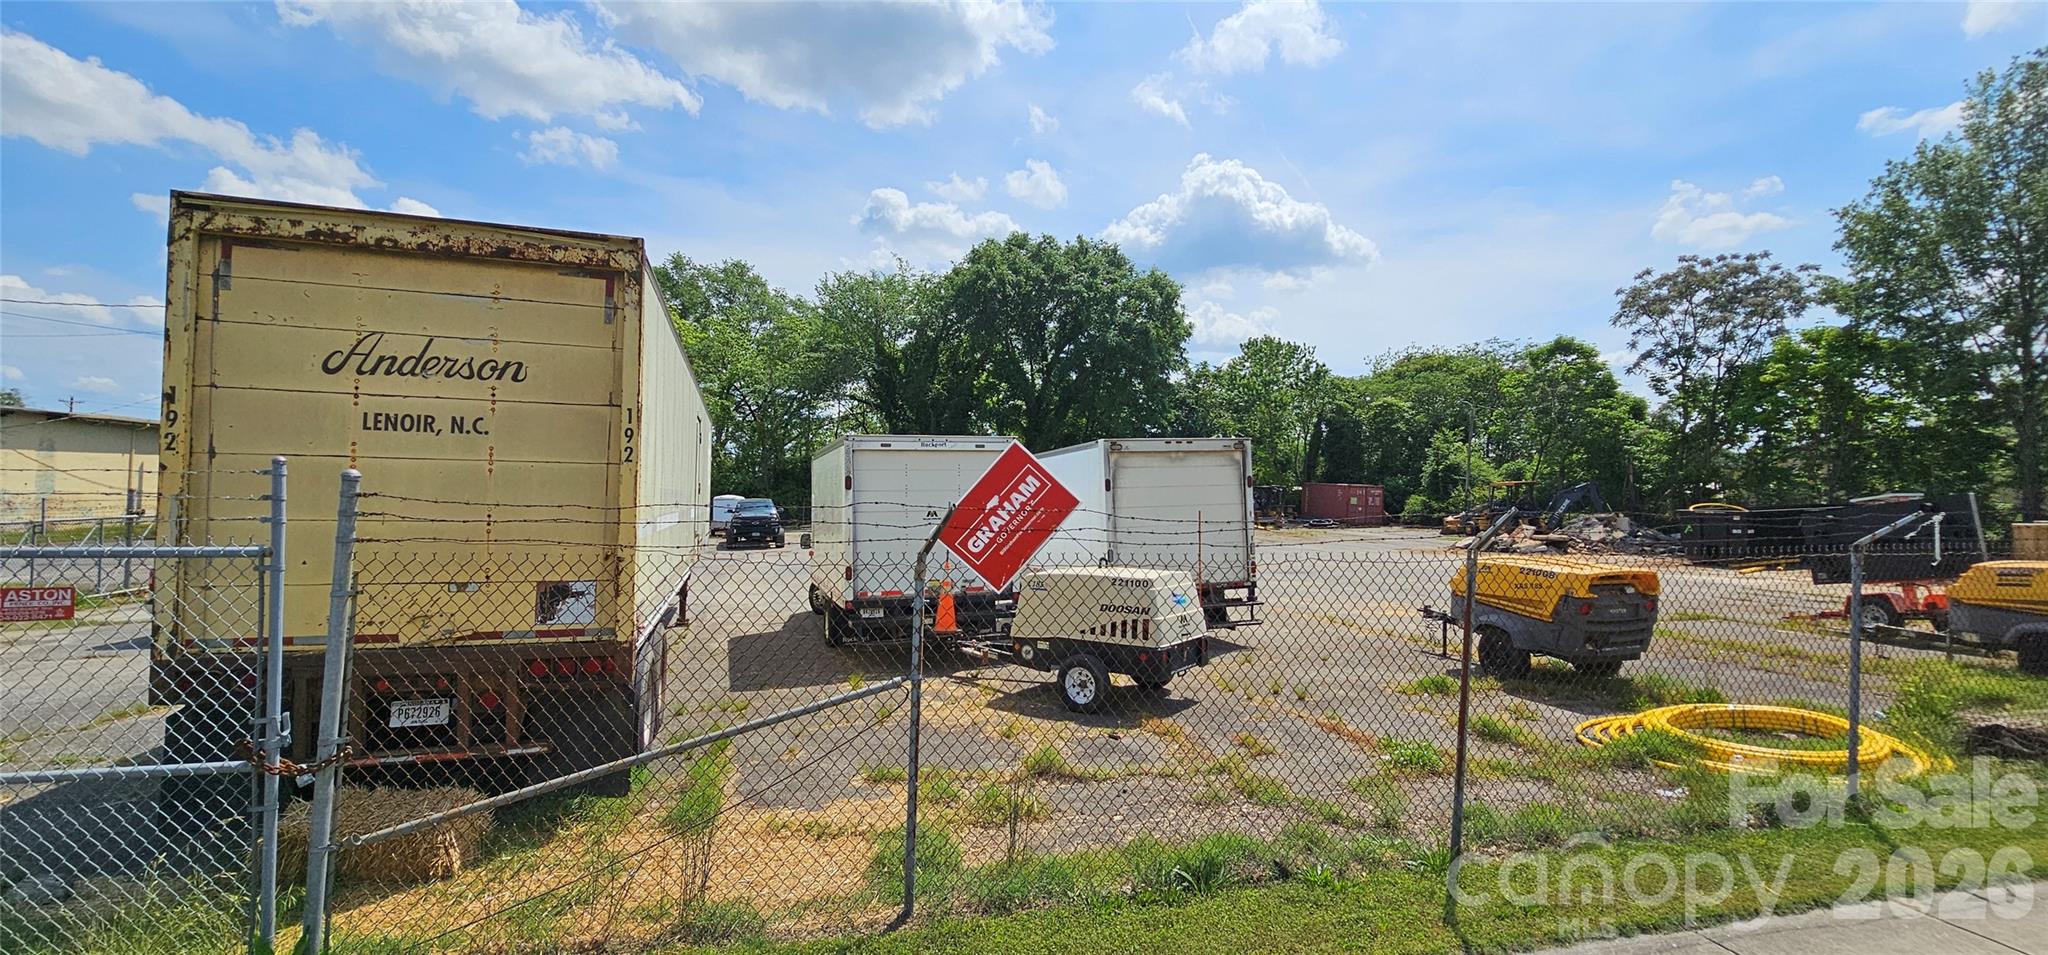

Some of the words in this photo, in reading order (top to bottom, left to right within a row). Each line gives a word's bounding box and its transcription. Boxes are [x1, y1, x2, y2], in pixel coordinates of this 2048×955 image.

[321, 332, 529, 383] Anderson
[362, 412, 442, 437] LENOIR,
[450, 415, 490, 436] N.C.
[624, 408, 635, 463] 192
[967, 474, 1041, 553] GRAHAM
[996, 504, 1032, 544] GOVERNOR
[0, 589, 72, 602] ASTON
[1111, 577, 1149, 588] 221100
[1099, 603, 1151, 616] DOOSAN
